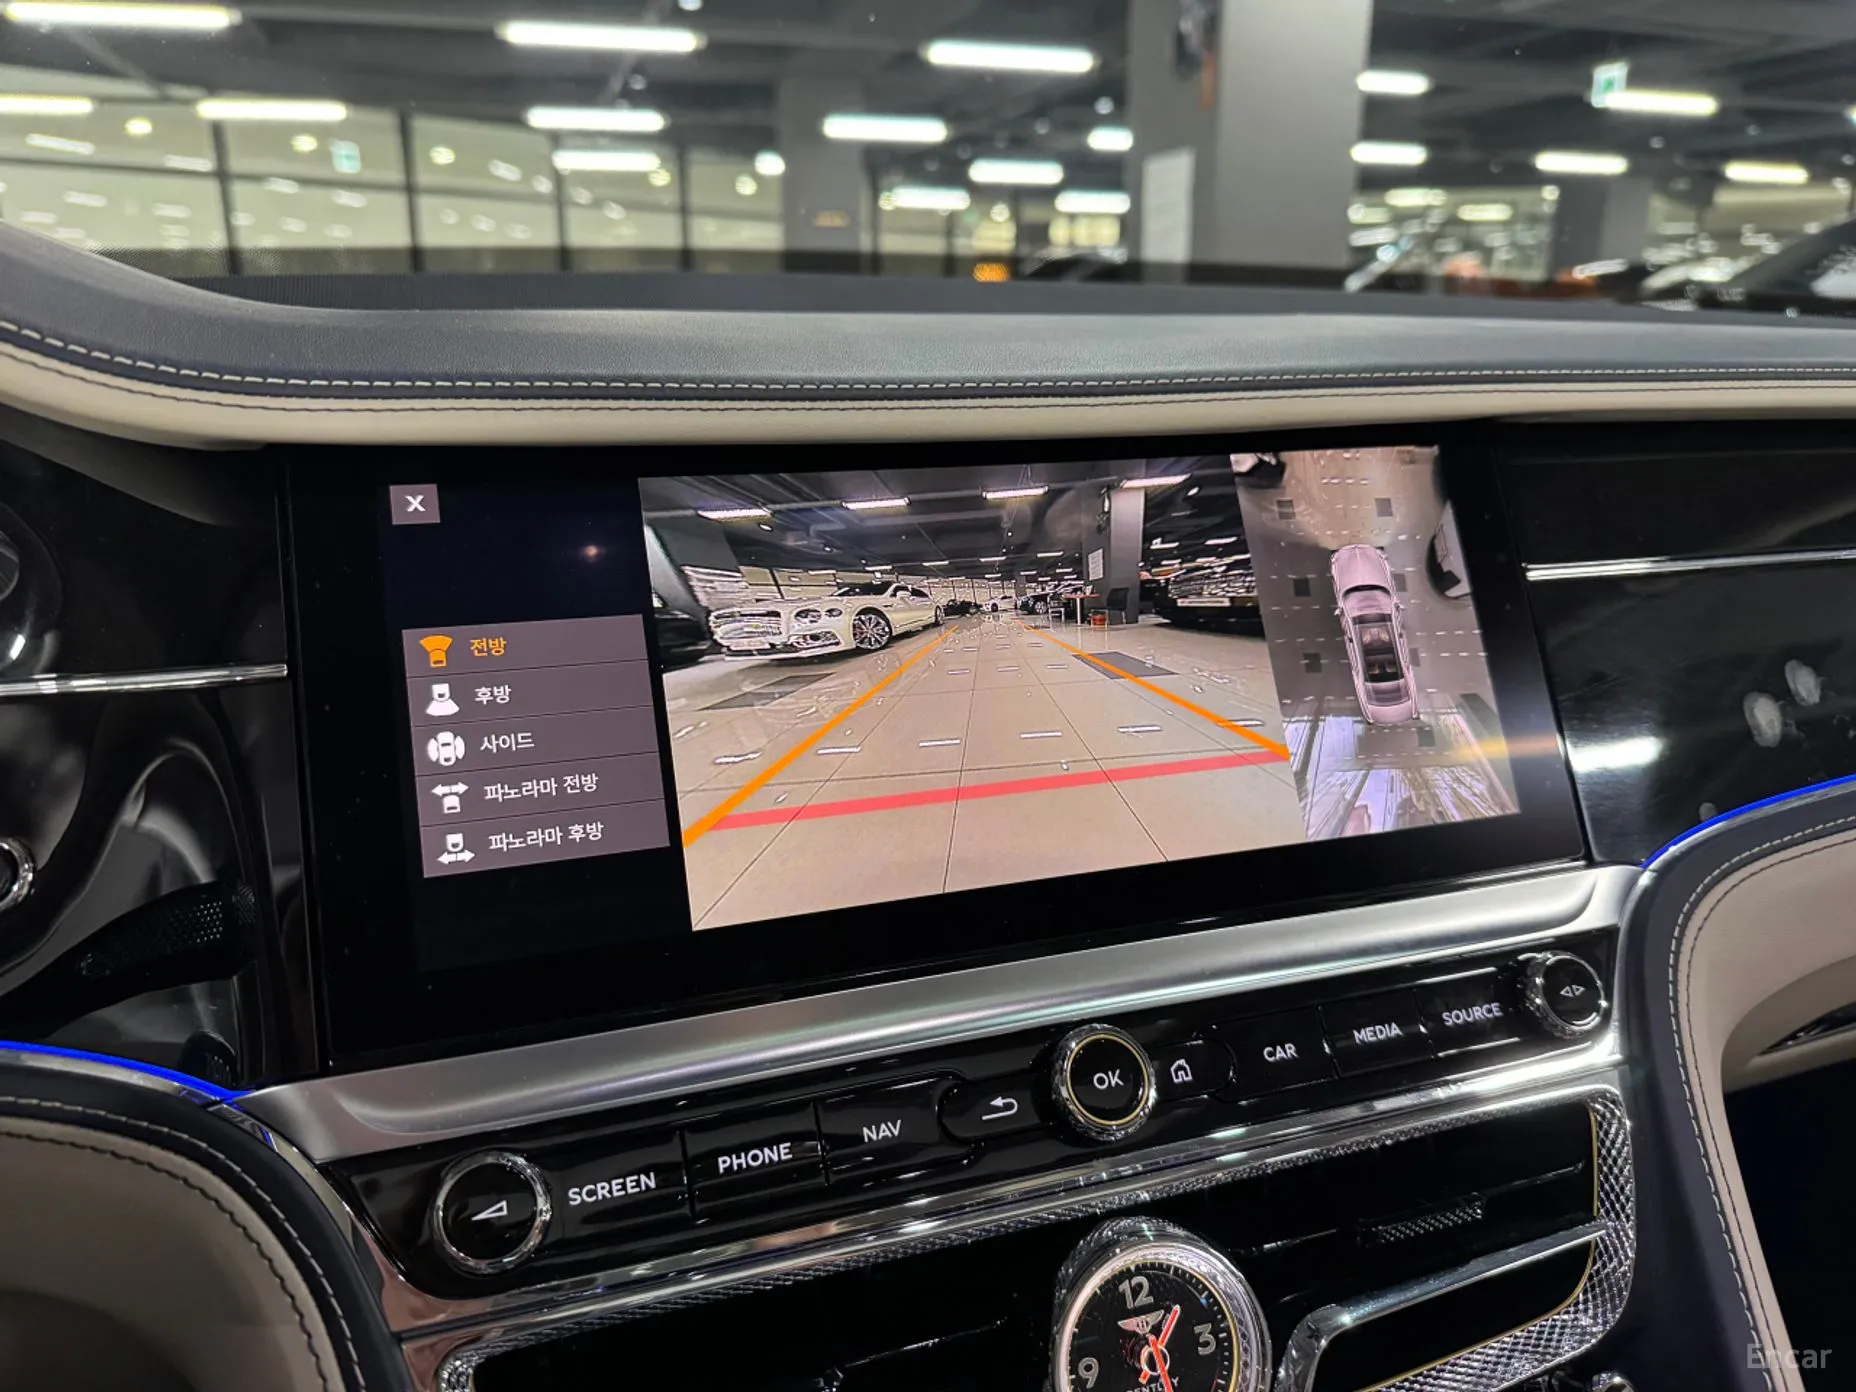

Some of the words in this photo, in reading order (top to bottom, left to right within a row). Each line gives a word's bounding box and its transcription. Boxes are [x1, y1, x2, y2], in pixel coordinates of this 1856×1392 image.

[470, 637, 507, 656] 전방
[475, 685, 512, 704] 후방
[480, 732, 535, 753] 사이드
[484, 777, 558, 802] 파노라마
[563, 773, 599, 793] 전방
[488, 826, 563, 852] 파노라마
[568, 822, 604, 842] 후방
[1441, 1002, 1502, 1026] SOURCE
[1353, 1022, 1402, 1043] MEDIA
[1263, 1043, 1297, 1063] CAR
[1092, 1069, 1125, 1090] OK
[862, 1119, 902, 1143] NAV
[717, 1142, 793, 1175] PHONE
[567, 1172, 656, 1206] SCREEN
[1118, 1275, 1154, 1310] 12
[1193, 1322, 1217, 1356] 3
[1077, 1357, 1099, 1389] 9
